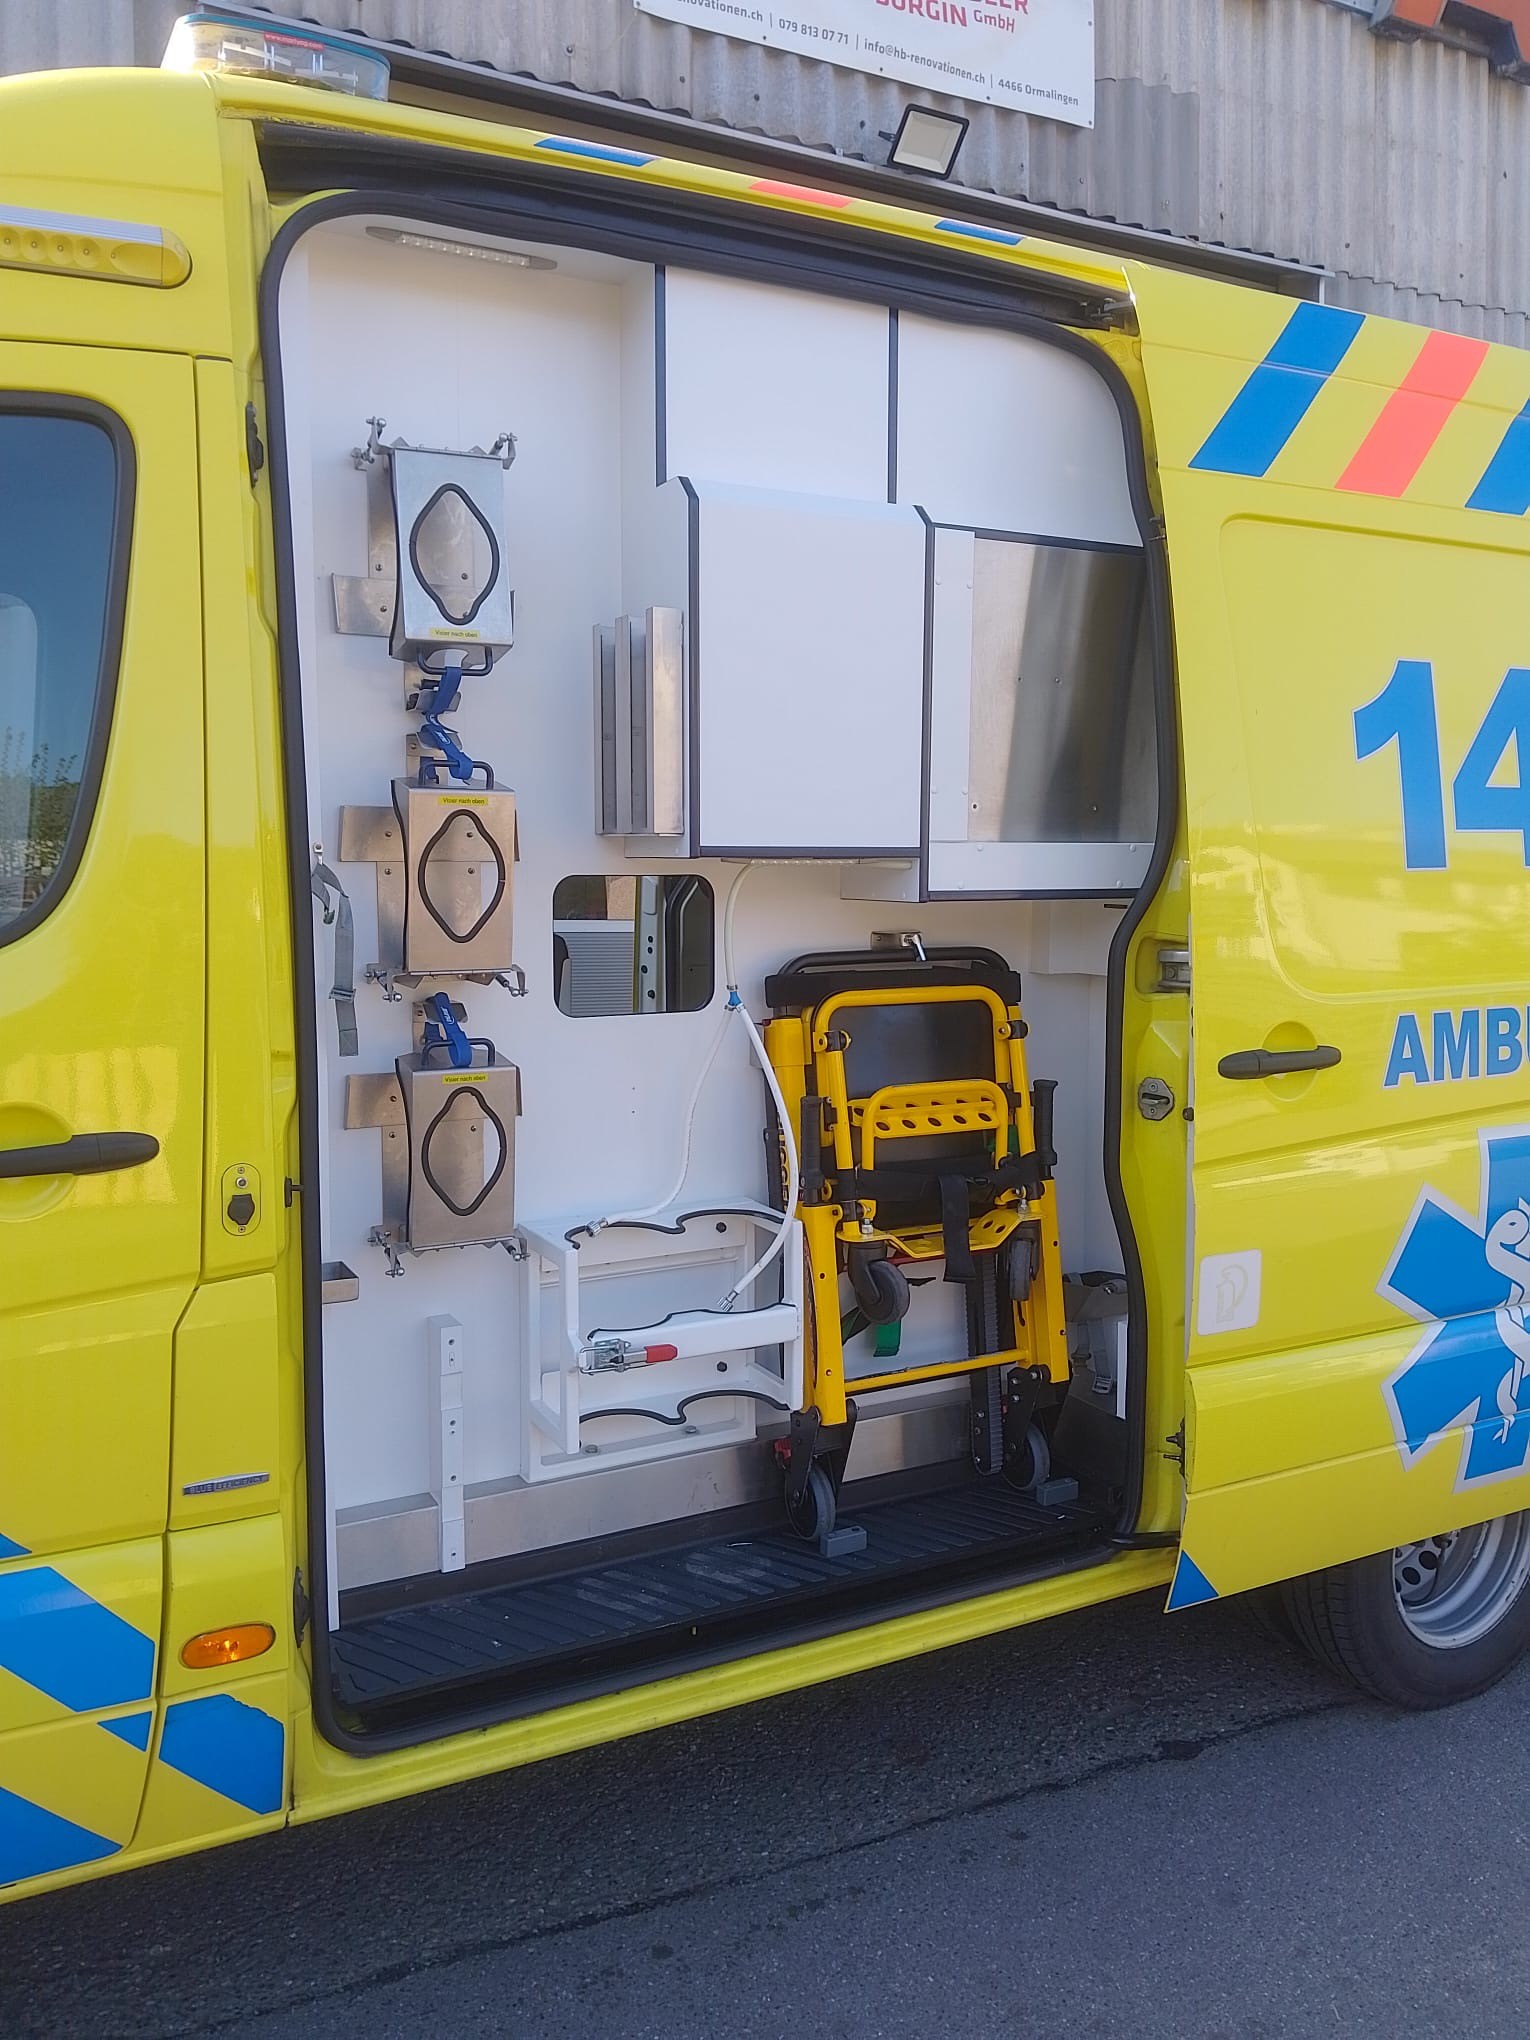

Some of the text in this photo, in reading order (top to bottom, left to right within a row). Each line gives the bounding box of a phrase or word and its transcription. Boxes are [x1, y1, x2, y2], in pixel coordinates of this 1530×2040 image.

[778, 18, 798, 32] 079
[801, 23, 819, 38] 813
[821, 29, 835, 41] 07
[837, 32, 849, 45] 71
[864, 38, 986, 84] info@hb-renovationen.ch
[998, 78, 1023, 93] 4466
[1025, 84, 1079, 107] Ormalingen
[973, 9, 1015, 34] GmbH
[1382, 1004, 1530, 1089] AMB
